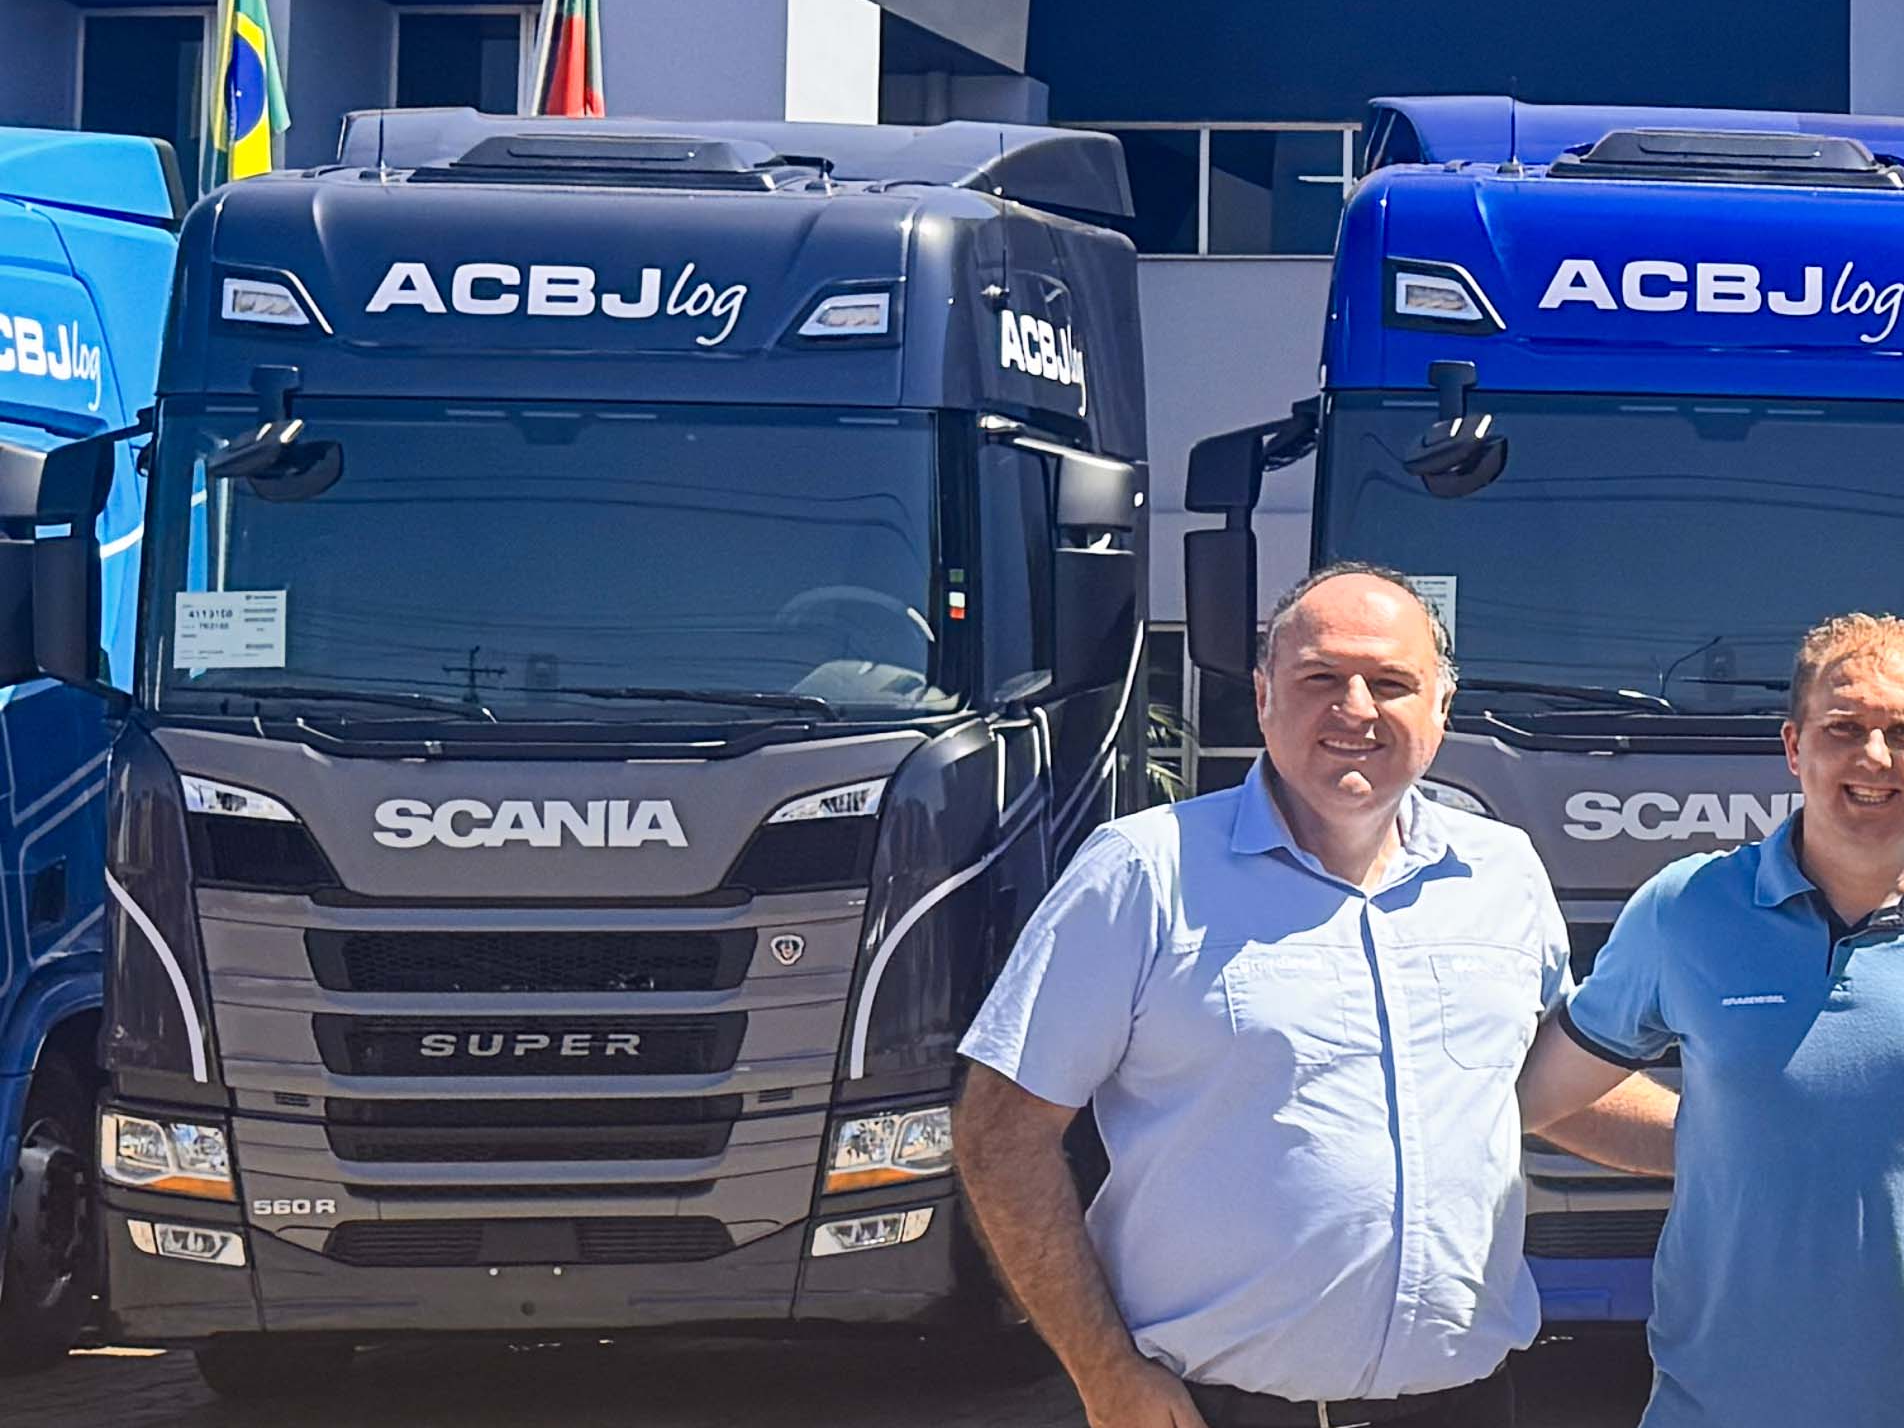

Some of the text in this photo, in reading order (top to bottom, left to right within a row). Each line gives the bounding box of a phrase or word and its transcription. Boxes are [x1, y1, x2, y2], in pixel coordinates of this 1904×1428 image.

[372, 798, 689, 849] SCANIA
[419, 1033, 641, 1057] SUPER
[253, 1198, 336, 1215] 560 R
